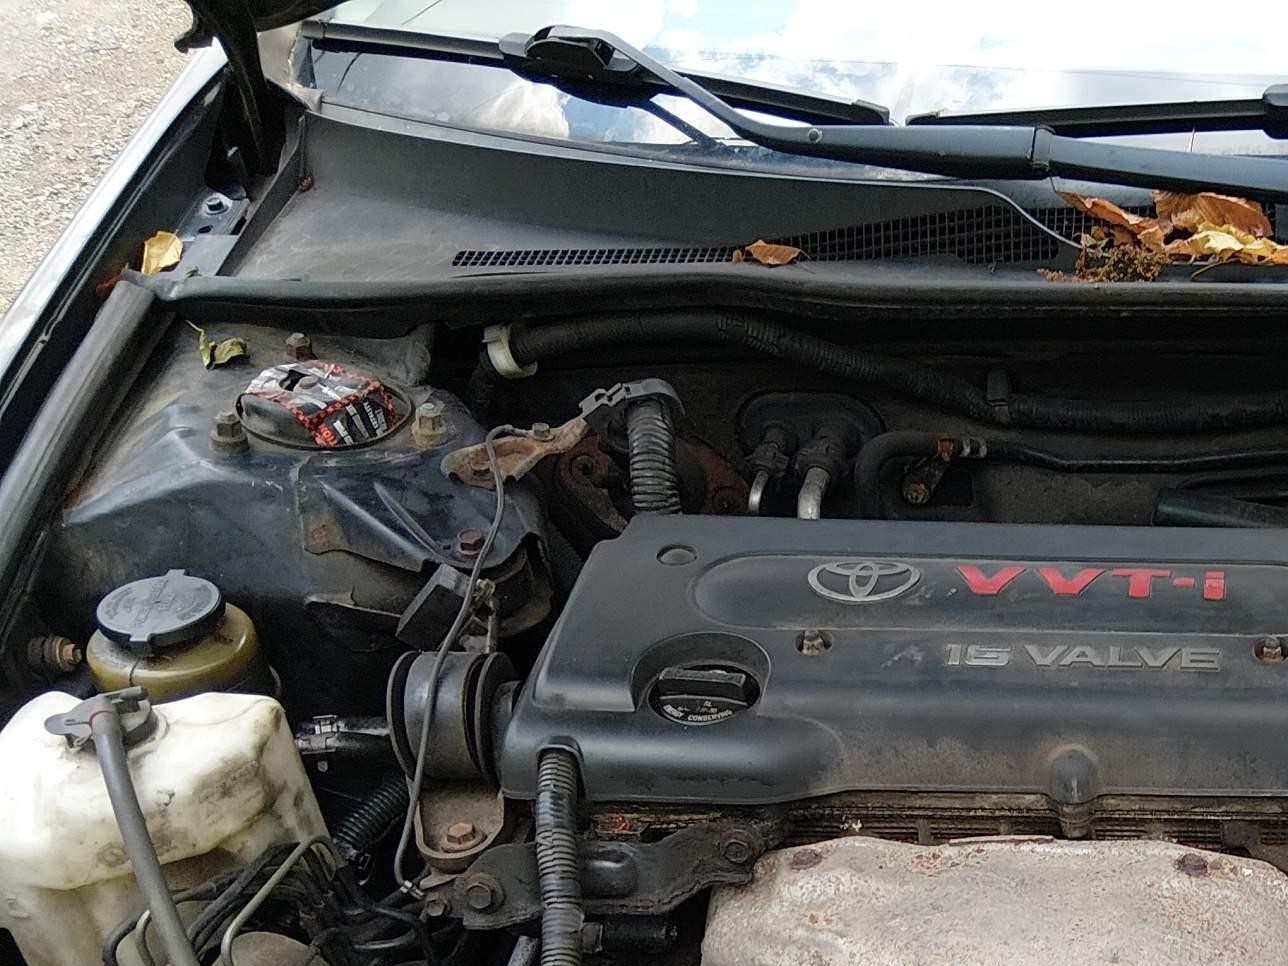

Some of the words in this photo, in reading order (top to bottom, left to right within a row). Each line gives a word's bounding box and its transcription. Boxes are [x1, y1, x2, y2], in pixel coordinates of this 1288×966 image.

[957, 566, 1226, 600] VVT-i
[945, 643, 1011, 667] 16
[1023, 644, 1222, 673] VALVE
